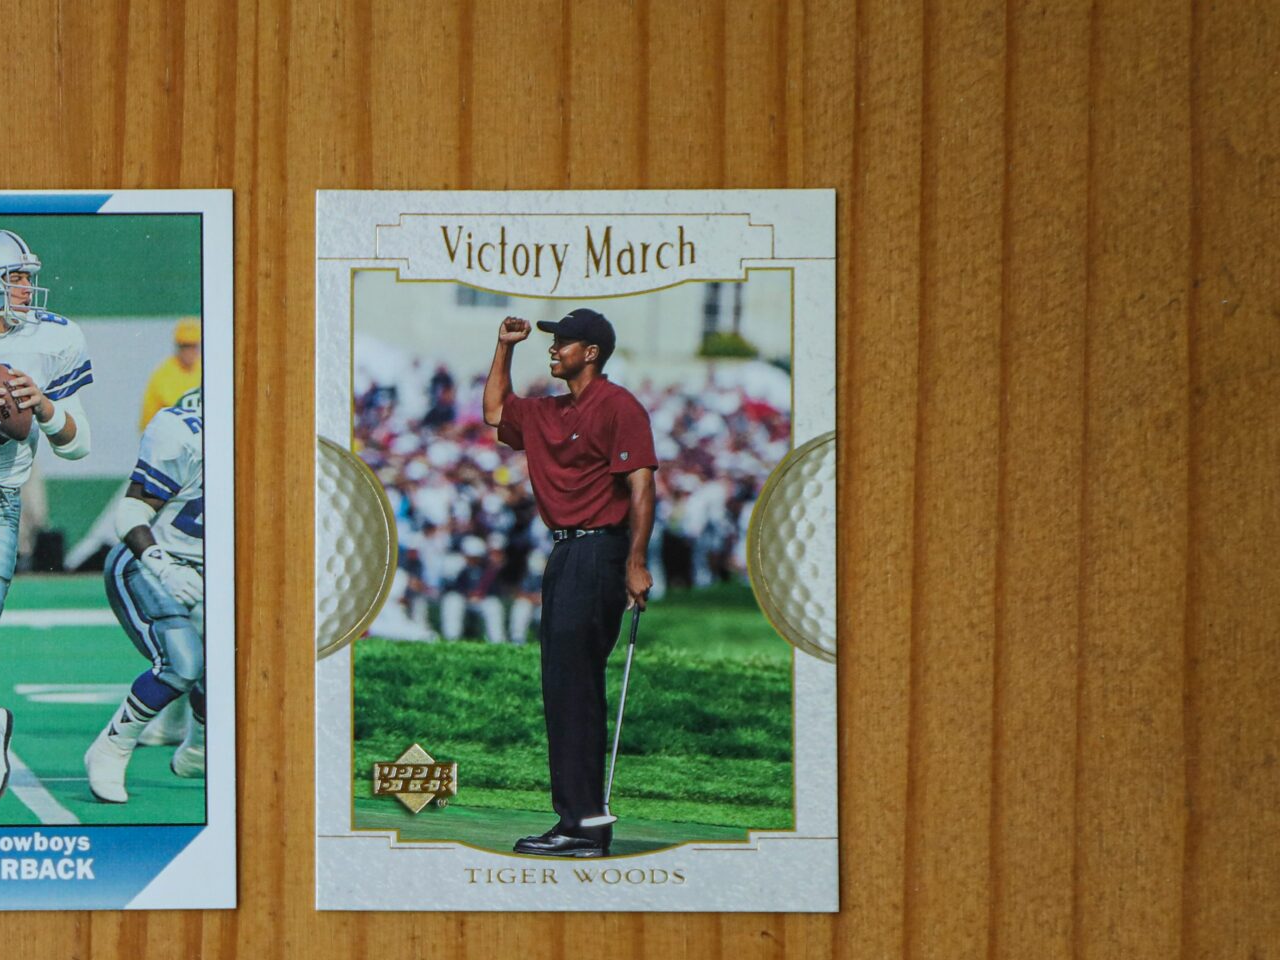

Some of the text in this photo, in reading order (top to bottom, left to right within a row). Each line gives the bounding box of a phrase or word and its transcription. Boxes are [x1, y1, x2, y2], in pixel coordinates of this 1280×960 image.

[440, 225, 697, 295] Victory March
[464, 867, 686, 885] TIGER WOODS
